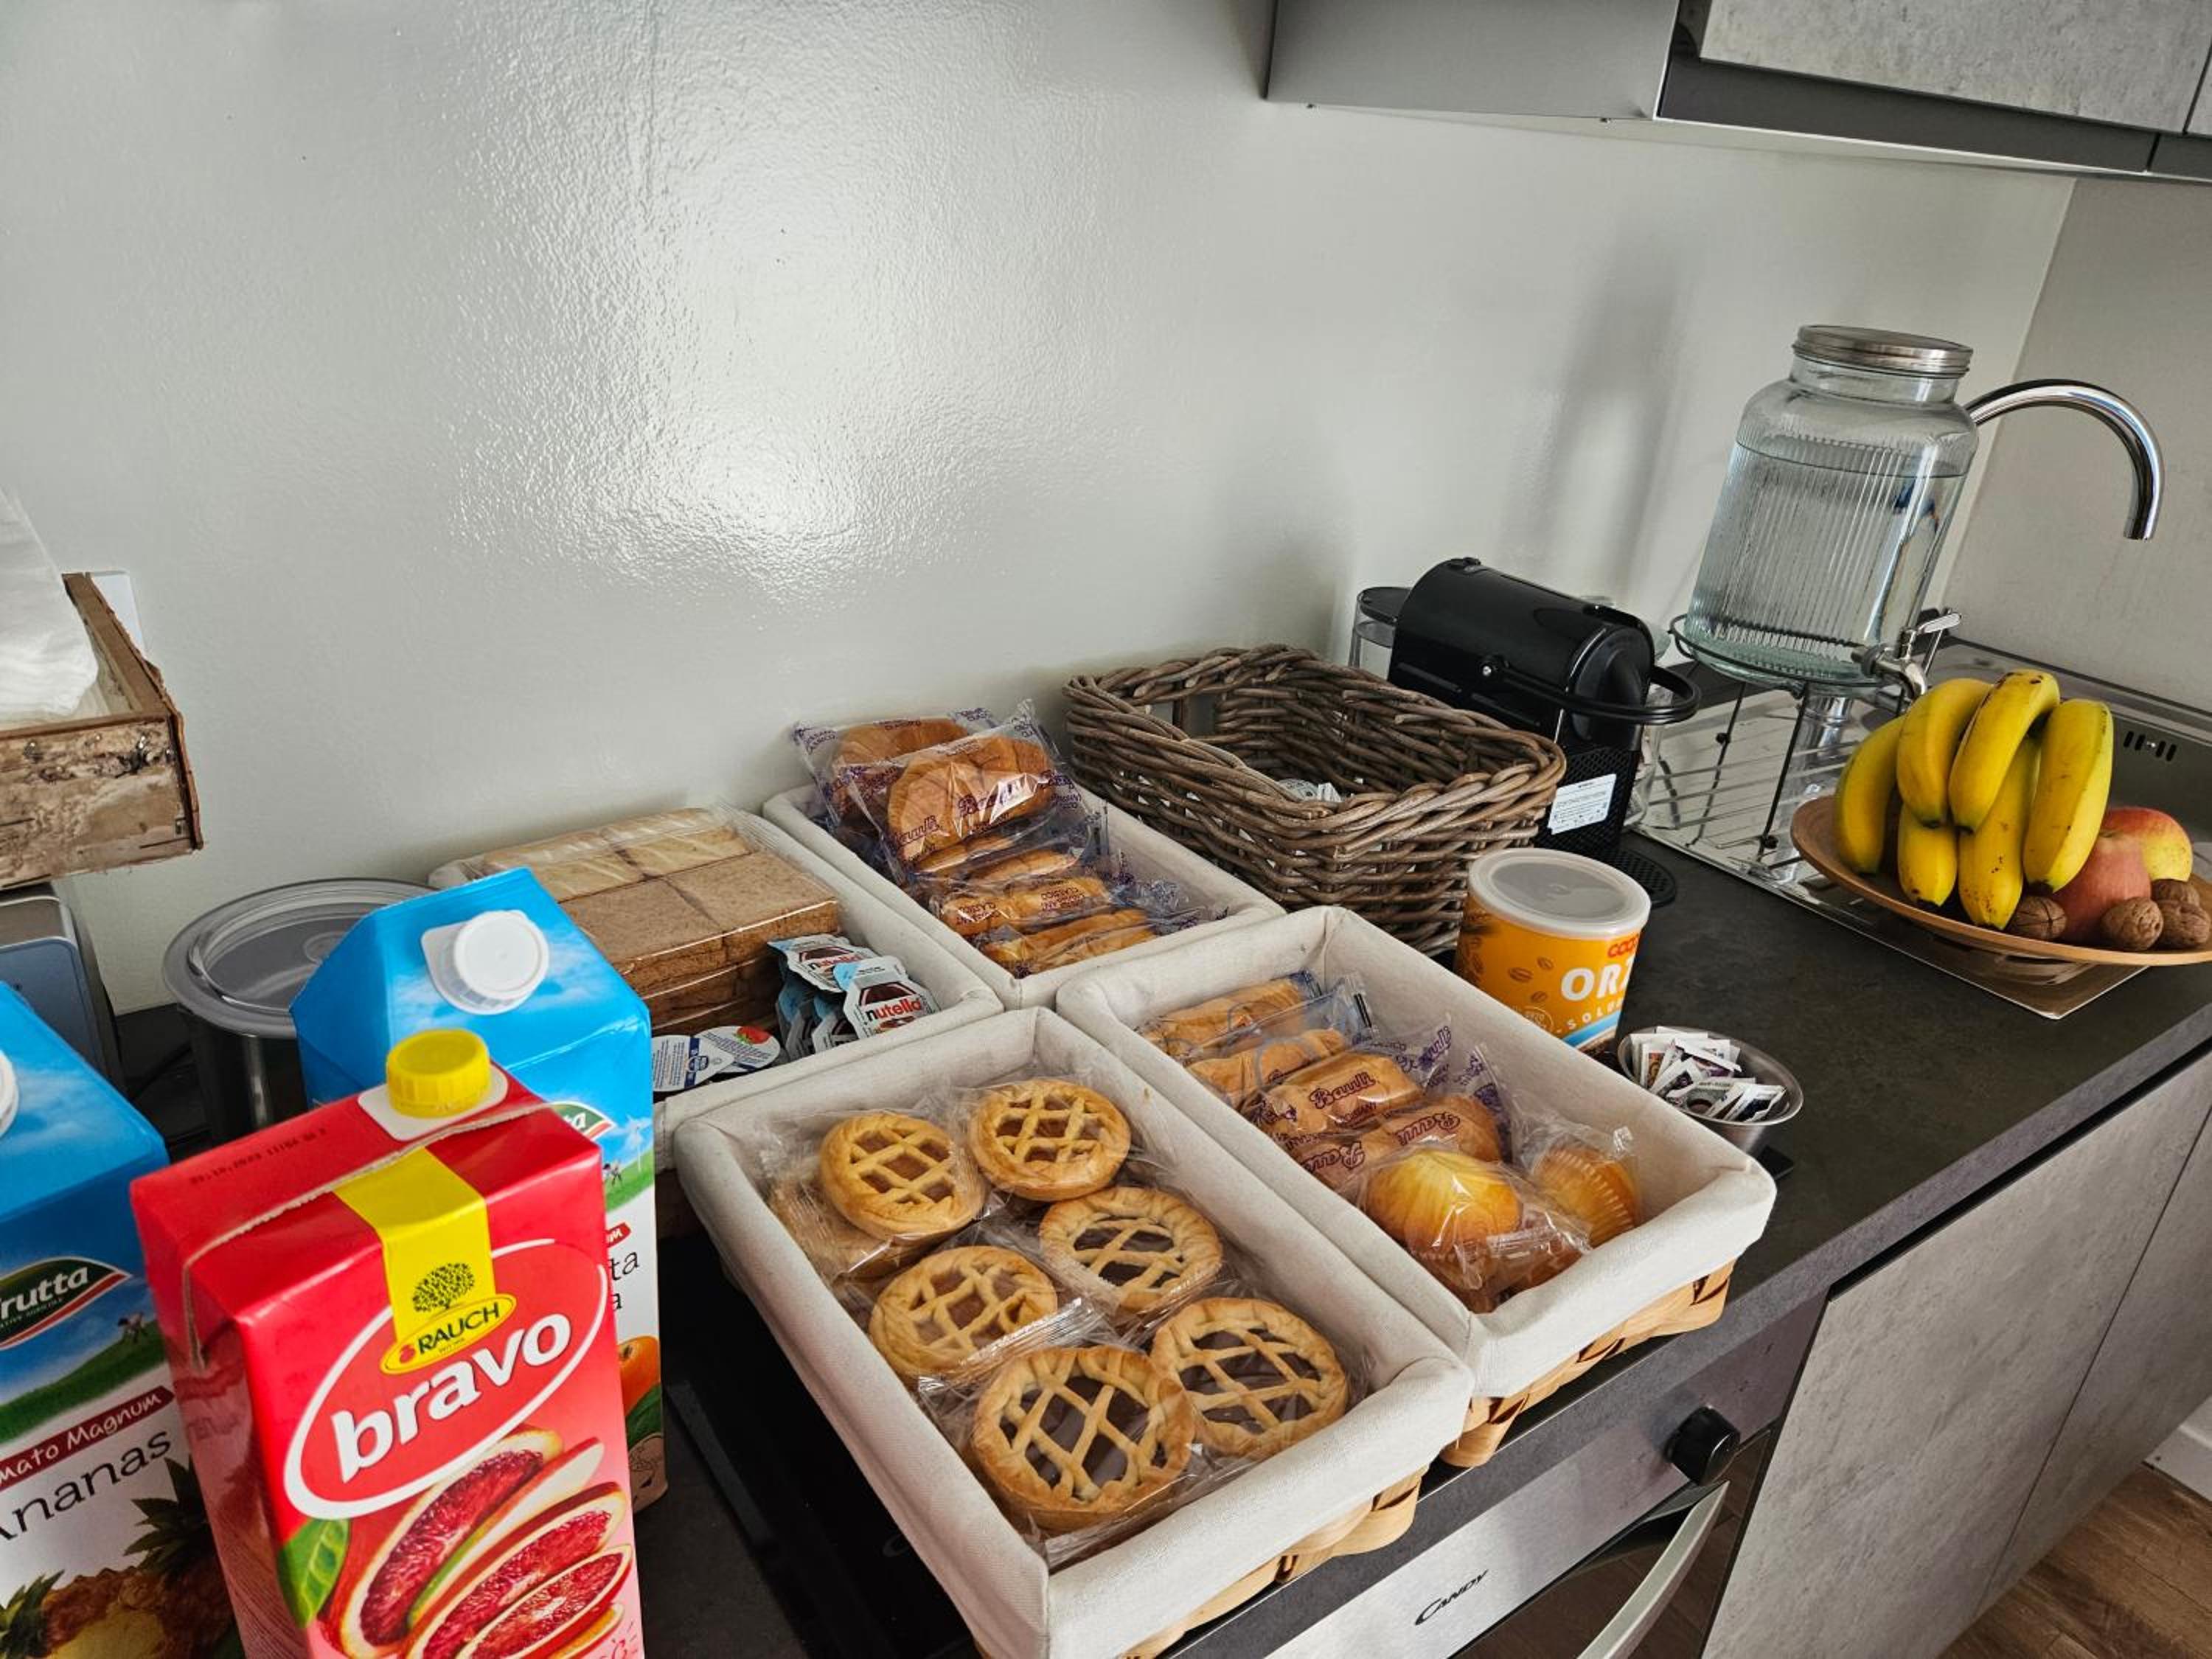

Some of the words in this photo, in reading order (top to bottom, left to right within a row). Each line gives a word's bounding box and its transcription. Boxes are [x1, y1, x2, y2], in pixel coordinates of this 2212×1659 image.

[866, 998, 922, 1022] nutella
[1309, 1071, 1377, 1110] Bauli
[0, 1267, 88, 1320] rutta
[417, 1301, 499, 1354] RAUCH
[66, 1394, 161, 1452] Magnum
[330, 1313, 572, 1484] bravo
